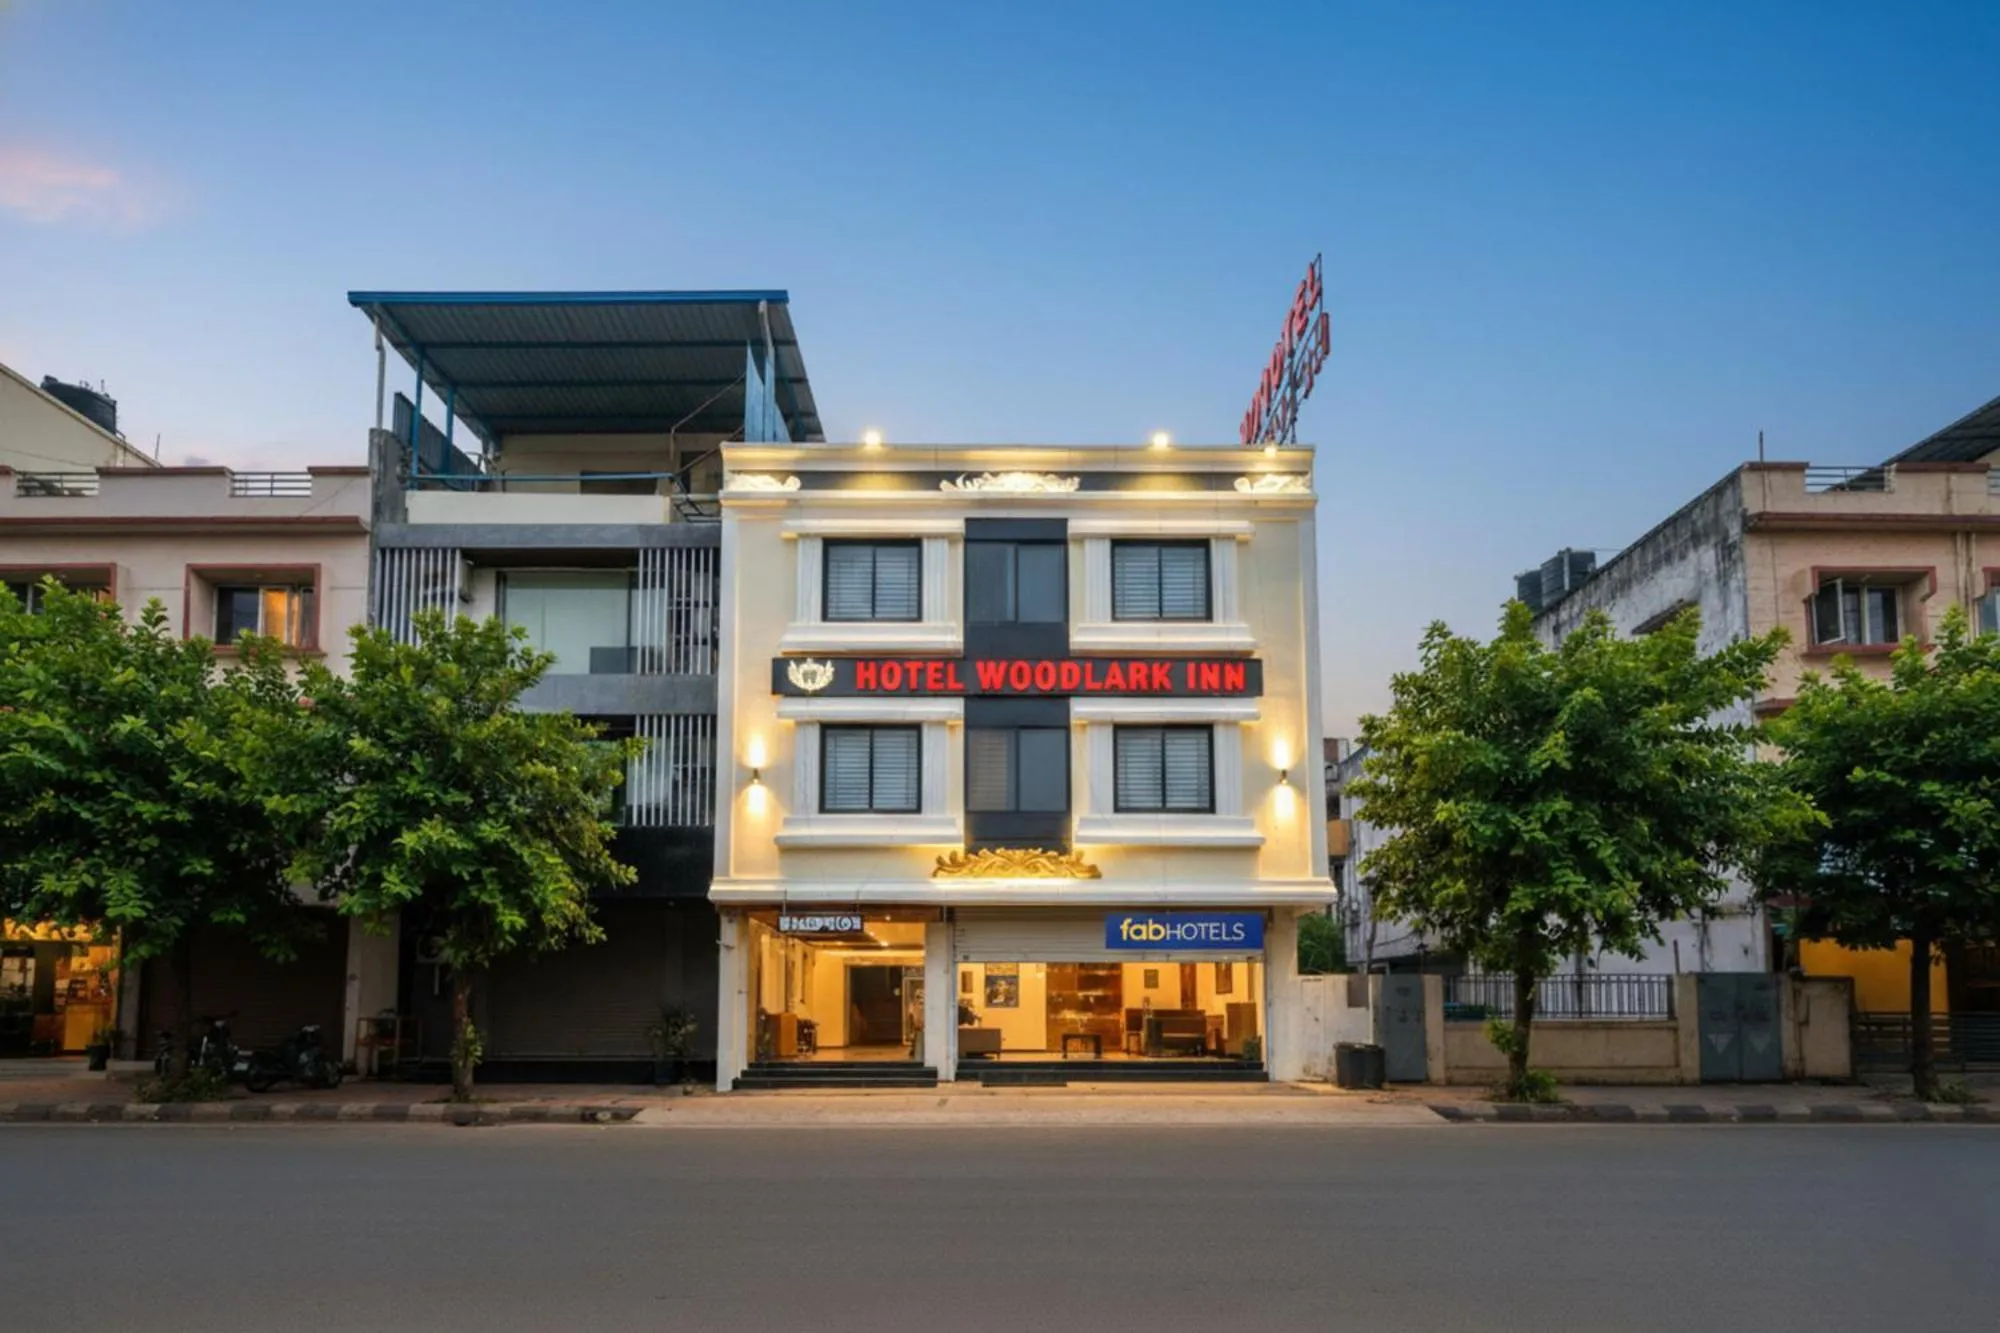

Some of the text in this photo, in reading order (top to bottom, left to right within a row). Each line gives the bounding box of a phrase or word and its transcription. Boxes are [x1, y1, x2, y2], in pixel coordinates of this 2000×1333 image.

[855, 659, 1246, 691] HOTEL WOODLARK INN
[1119, 917, 1245, 941] fabHOTELS
